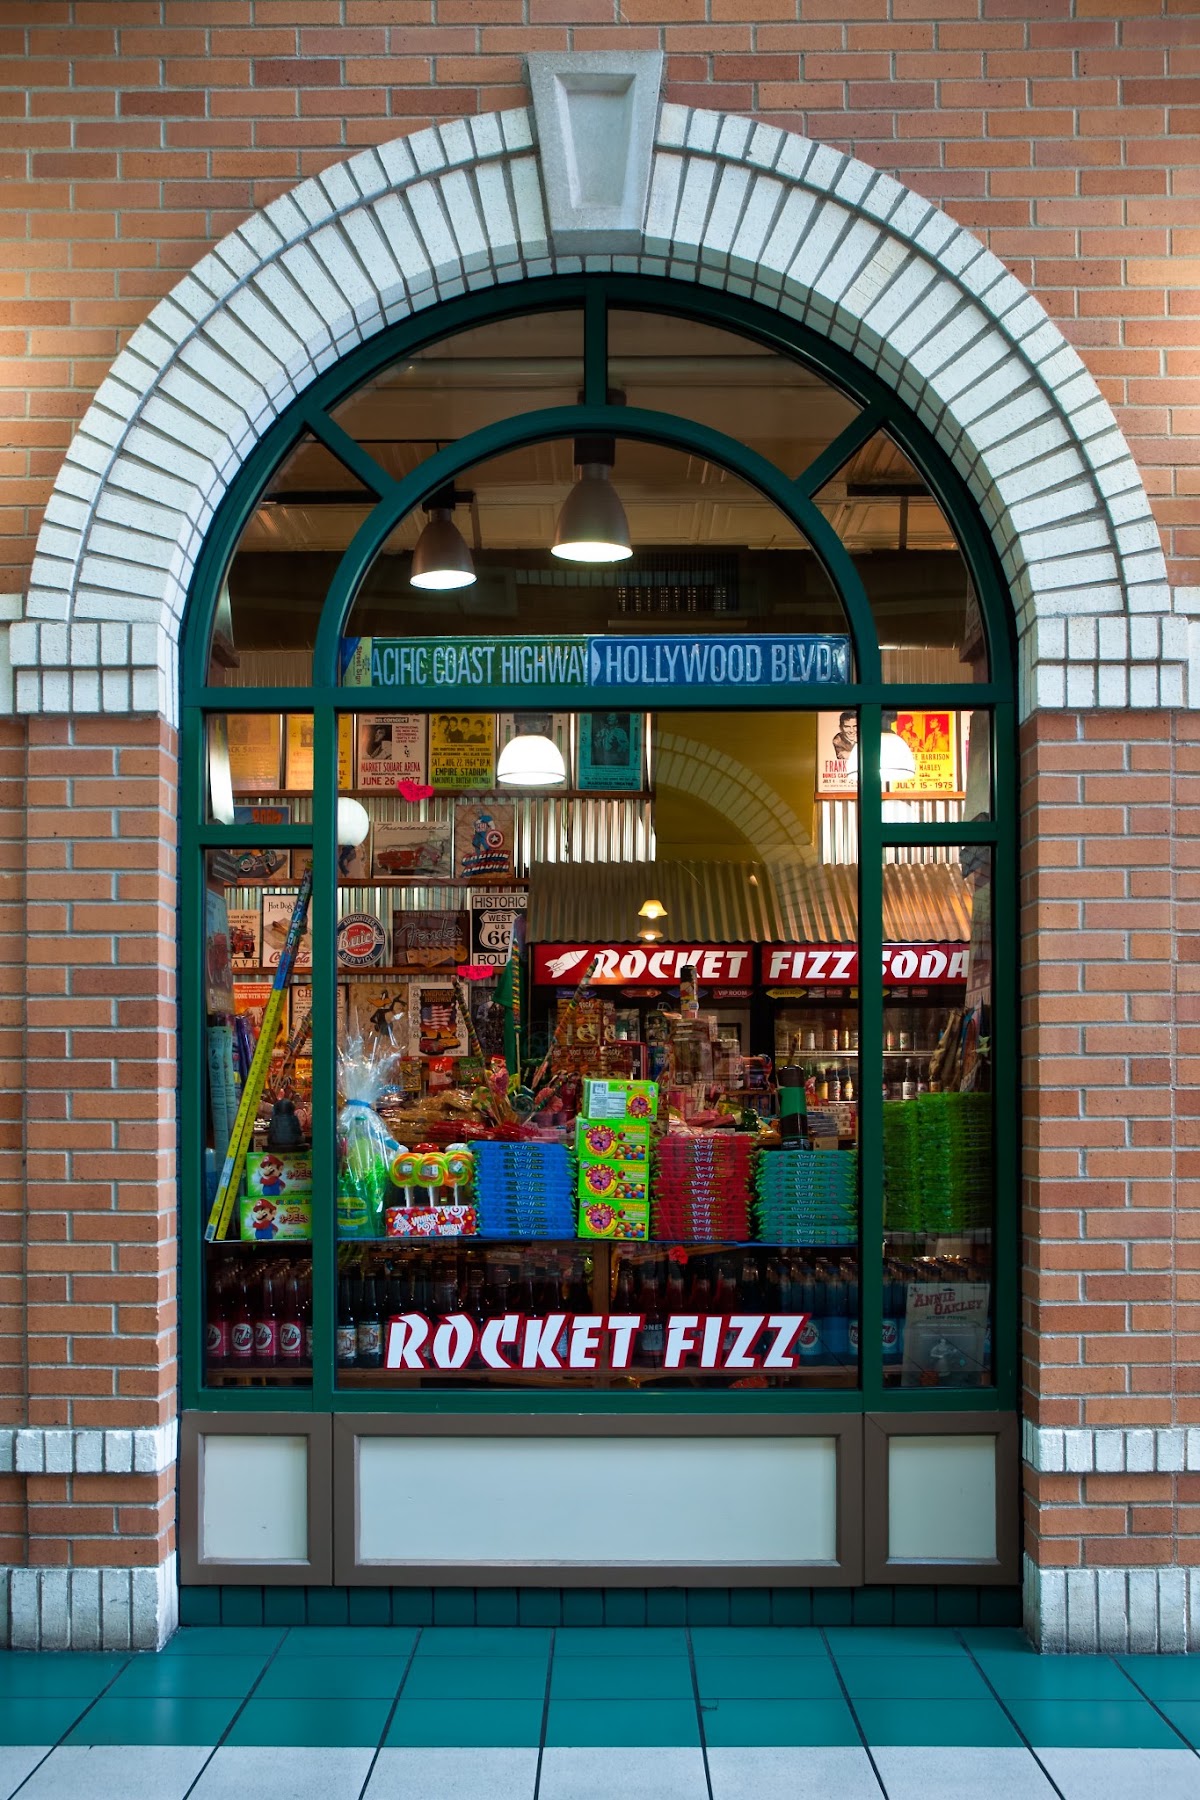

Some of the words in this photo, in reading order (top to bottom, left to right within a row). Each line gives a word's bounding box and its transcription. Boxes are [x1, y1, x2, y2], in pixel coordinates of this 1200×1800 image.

[373, 647, 428, 685] ACIFIC
[432, 646, 495, 685] COAST
[502, 645, 588, 683] HIGHWAY
[606, 644, 762, 682] HOLLYWOOD
[771, 644, 832, 682] BLVD
[383, 761, 402, 772] SQUARE
[404, 761, 420, 772] ARENA
[435, 768, 457, 776] EMPIRE
[460, 768, 488, 776] STADIUM
[825, 760, 847, 772] FRANK
[361, 777, 382, 785] JUNE
[384, 777, 395, 785] 26
[474, 896, 526, 908] HISTORIC
[488, 914, 511, 922] WEST
[338, 926, 385, 951] Buick
[395, 917, 464, 948] Fender
[488, 930, 511, 945] 66
[233, 960, 258, 968] AVE
[342, 952, 376, 965] SERVICE
[477, 954, 508, 965] ROU
[594, 949, 748, 978] ROCKET
[769, 951, 857, 979] FIZZ
[913, 1292, 955, 1307] ANNIE
[934, 1300, 984, 1315] OAKLEY
[643, 1323, 663, 1331] ONES
[385, 1312, 645, 1369] ROCKET
[663, 1313, 809, 1369] FIZZ
